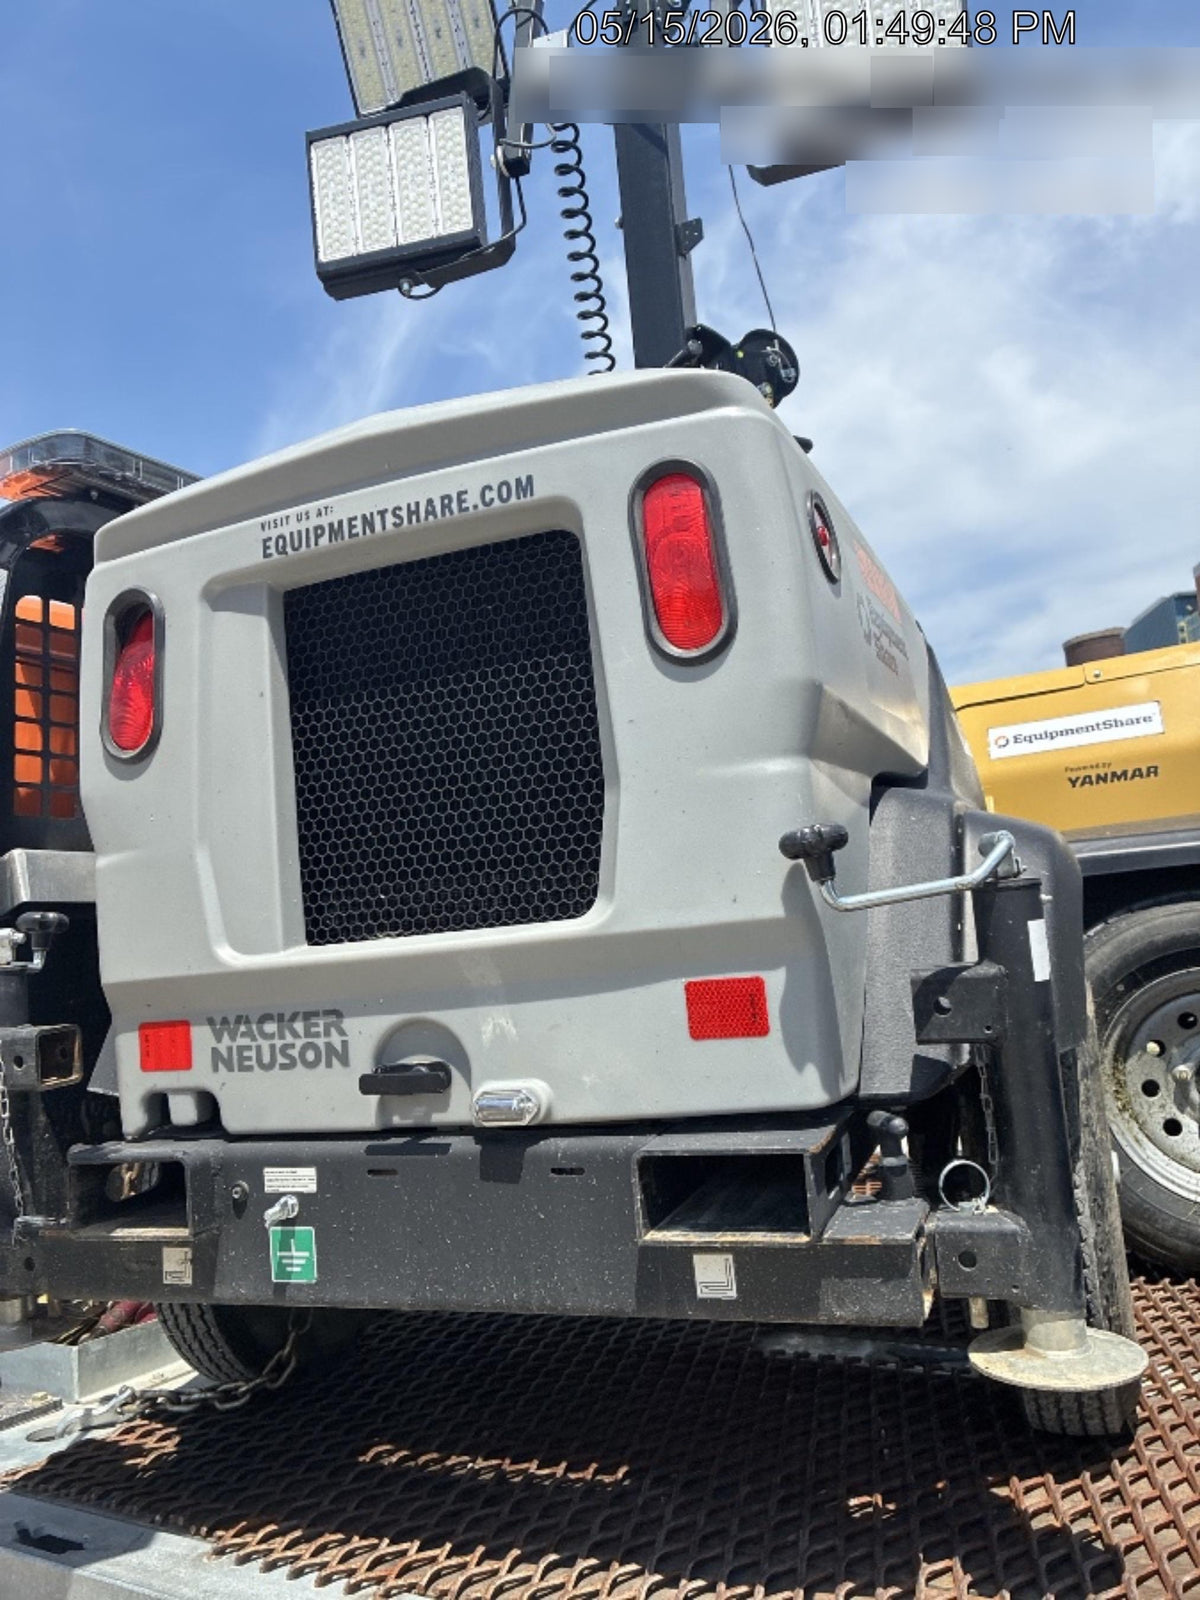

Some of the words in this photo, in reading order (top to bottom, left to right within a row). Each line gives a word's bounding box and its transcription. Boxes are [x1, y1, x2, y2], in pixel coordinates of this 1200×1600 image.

[261, 474, 535, 559] EQUIPMENTSHARE.COM
[261, 515, 290, 531] VISIT
[296, 511, 310, 523] US
[316, 506, 333, 518] AT:
[1012, 714, 1153, 745] EquipmentShare
[1067, 765, 1159, 788] YANMAR
[206, 1009, 349, 1043] WACKER
[210, 1040, 350, 1073] NEUSON
